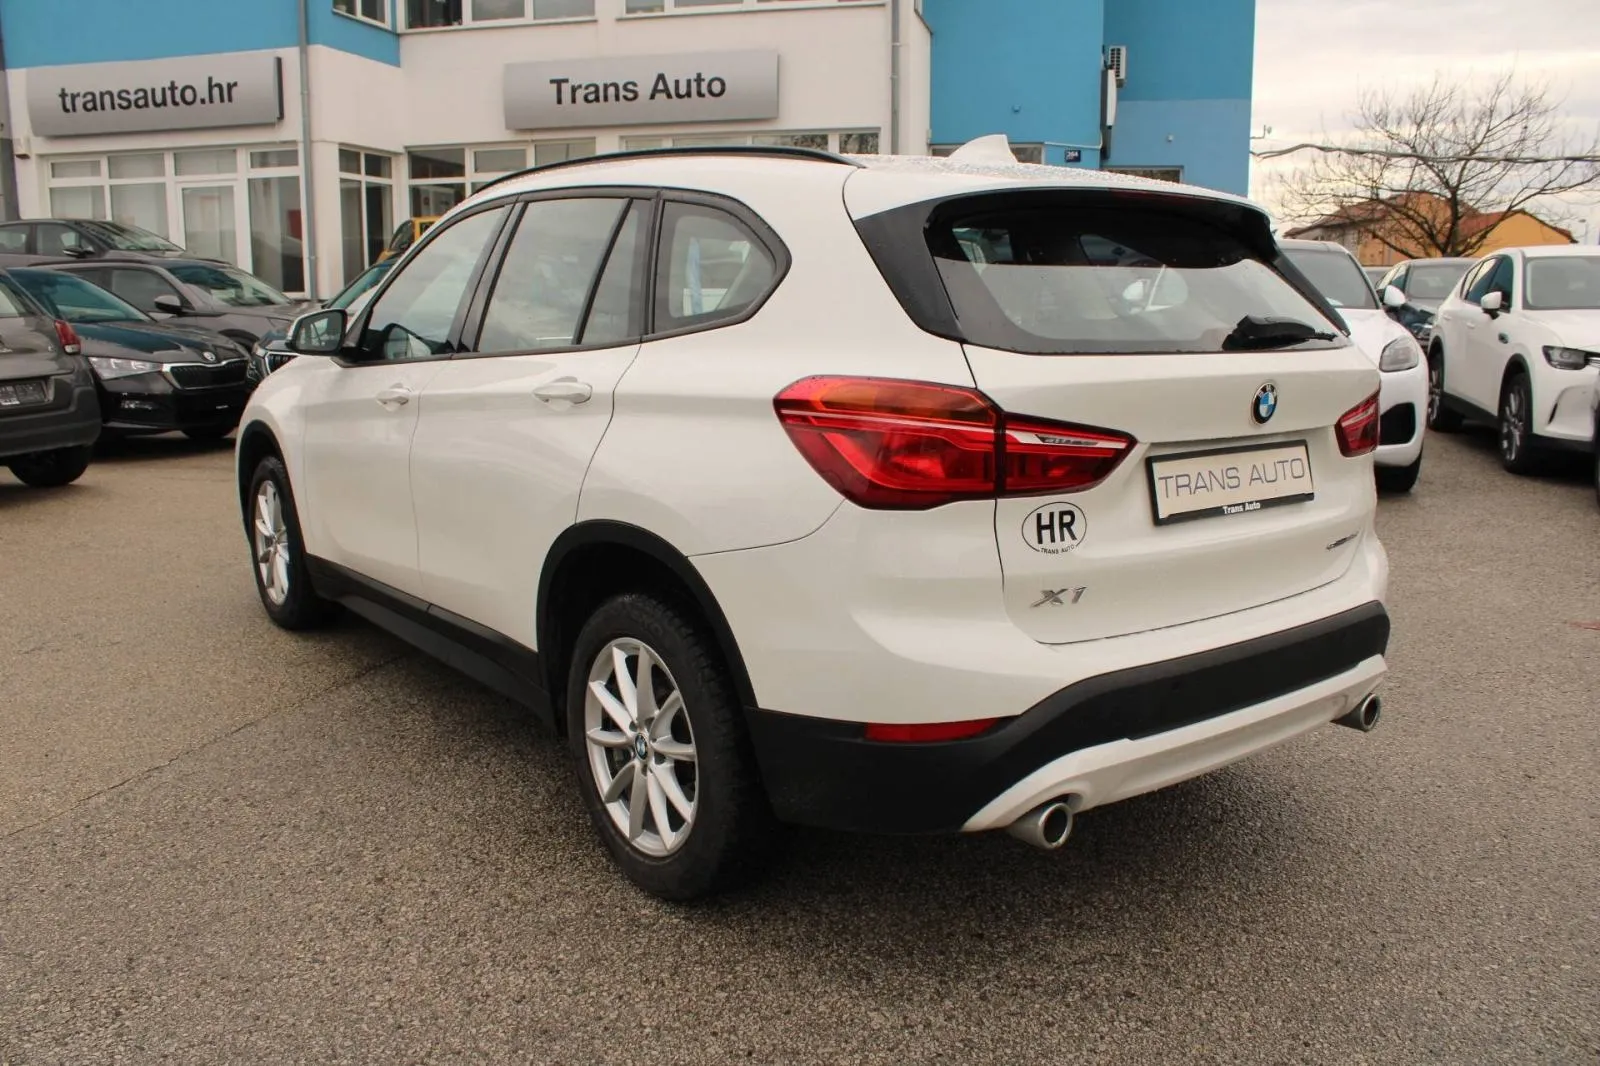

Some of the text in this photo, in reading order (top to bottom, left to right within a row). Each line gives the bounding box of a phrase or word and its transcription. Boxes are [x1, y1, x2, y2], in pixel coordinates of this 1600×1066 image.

[59, 76, 238, 113] transauto.hr
[549, 72, 726, 105] Trans Auto
[1158, 458, 1305, 498] TRANS AUTO
[1223, 501, 1261, 514] Trans Auto
[1036, 510, 1077, 545] HR
[1040, 544, 1075, 555] TRANS AUTO
[1030, 587, 1087, 608] X1
